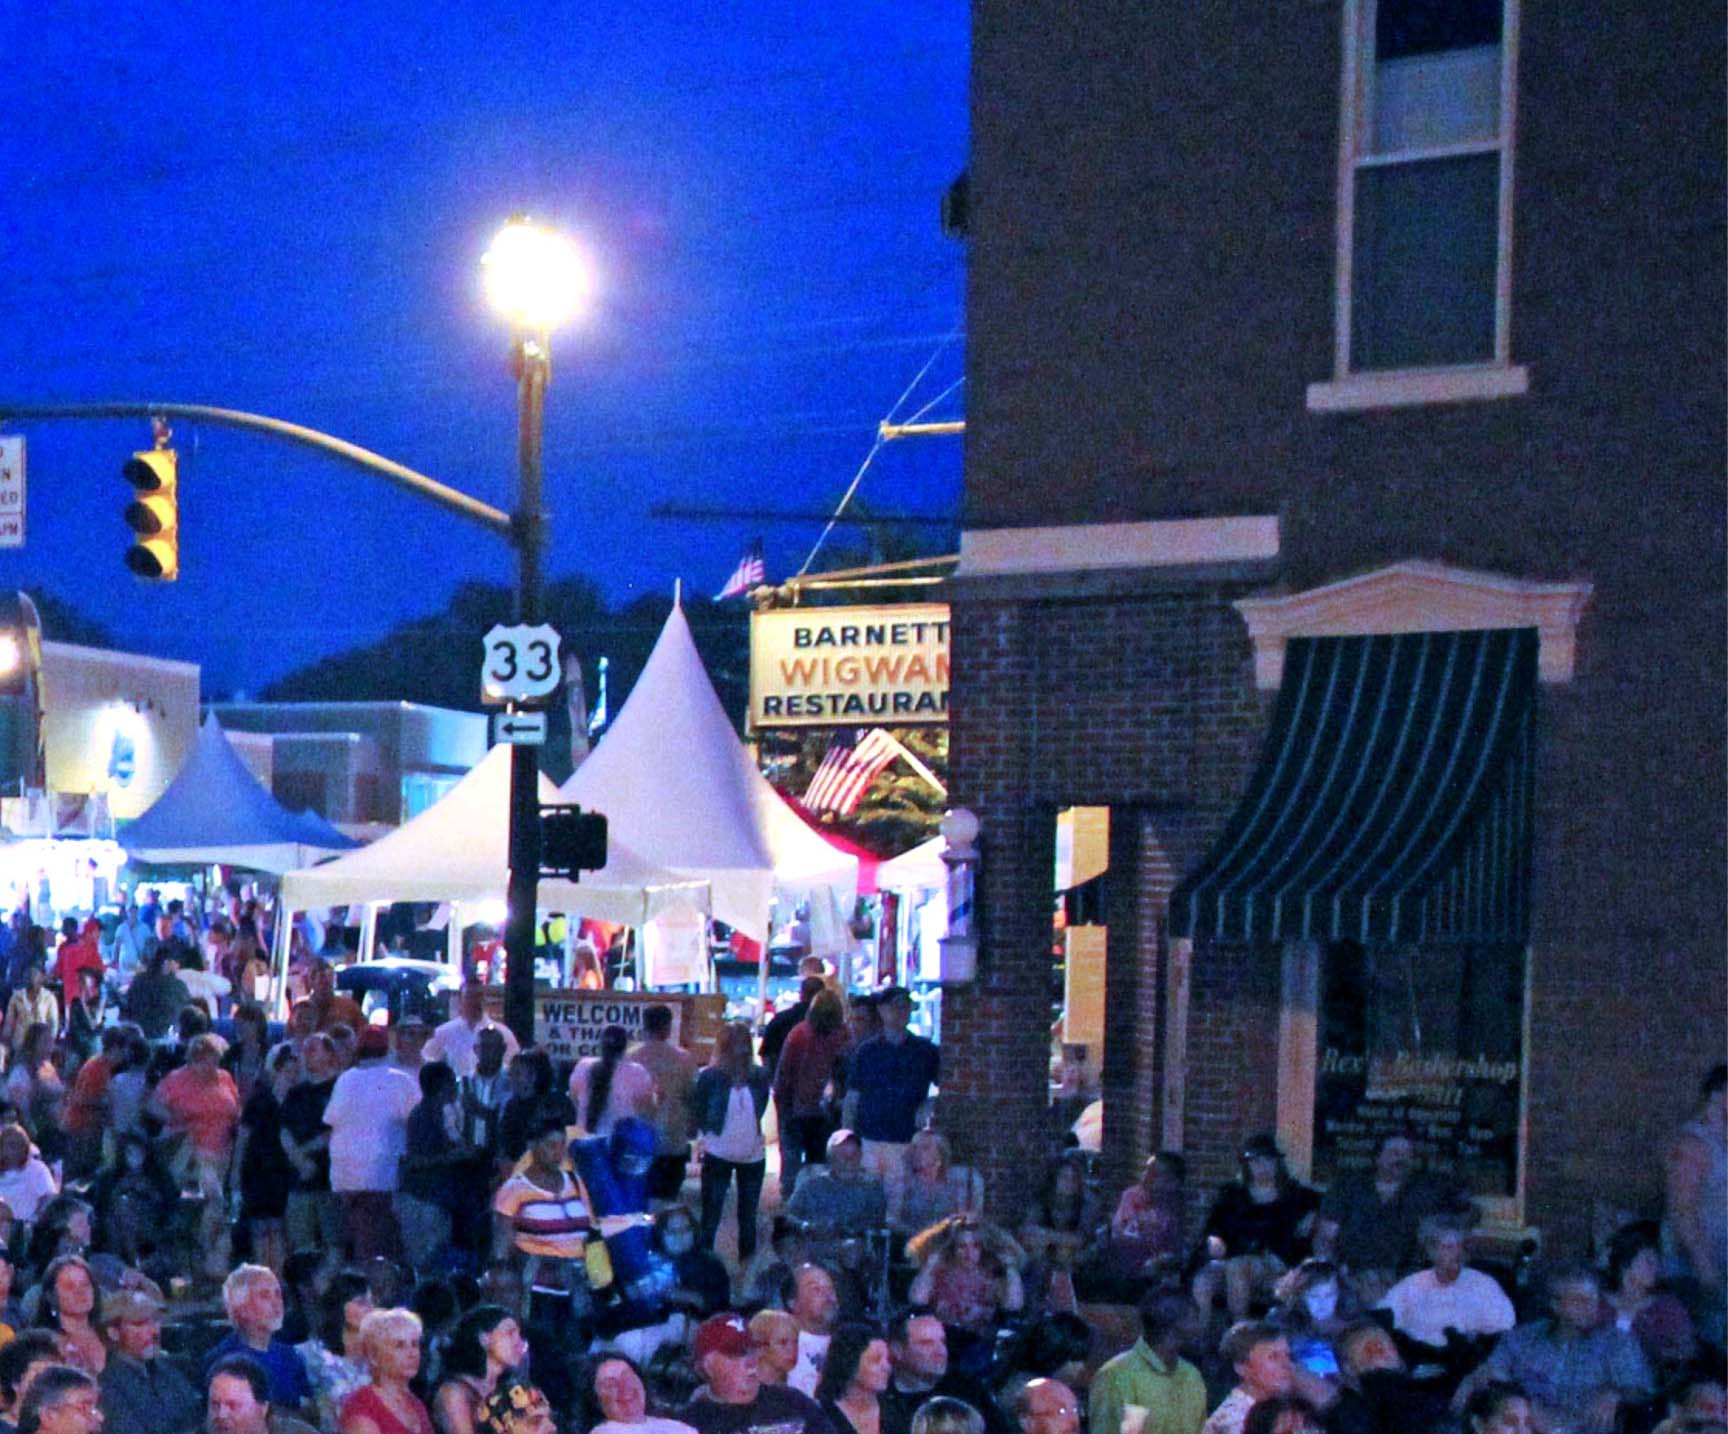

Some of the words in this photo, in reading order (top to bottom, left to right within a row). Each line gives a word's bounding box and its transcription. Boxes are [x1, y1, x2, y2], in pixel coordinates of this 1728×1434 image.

[492, 640, 553, 681] 33
[763, 690, 949, 716] RESTAURA
[543, 1004, 640, 1025] WELCOM
